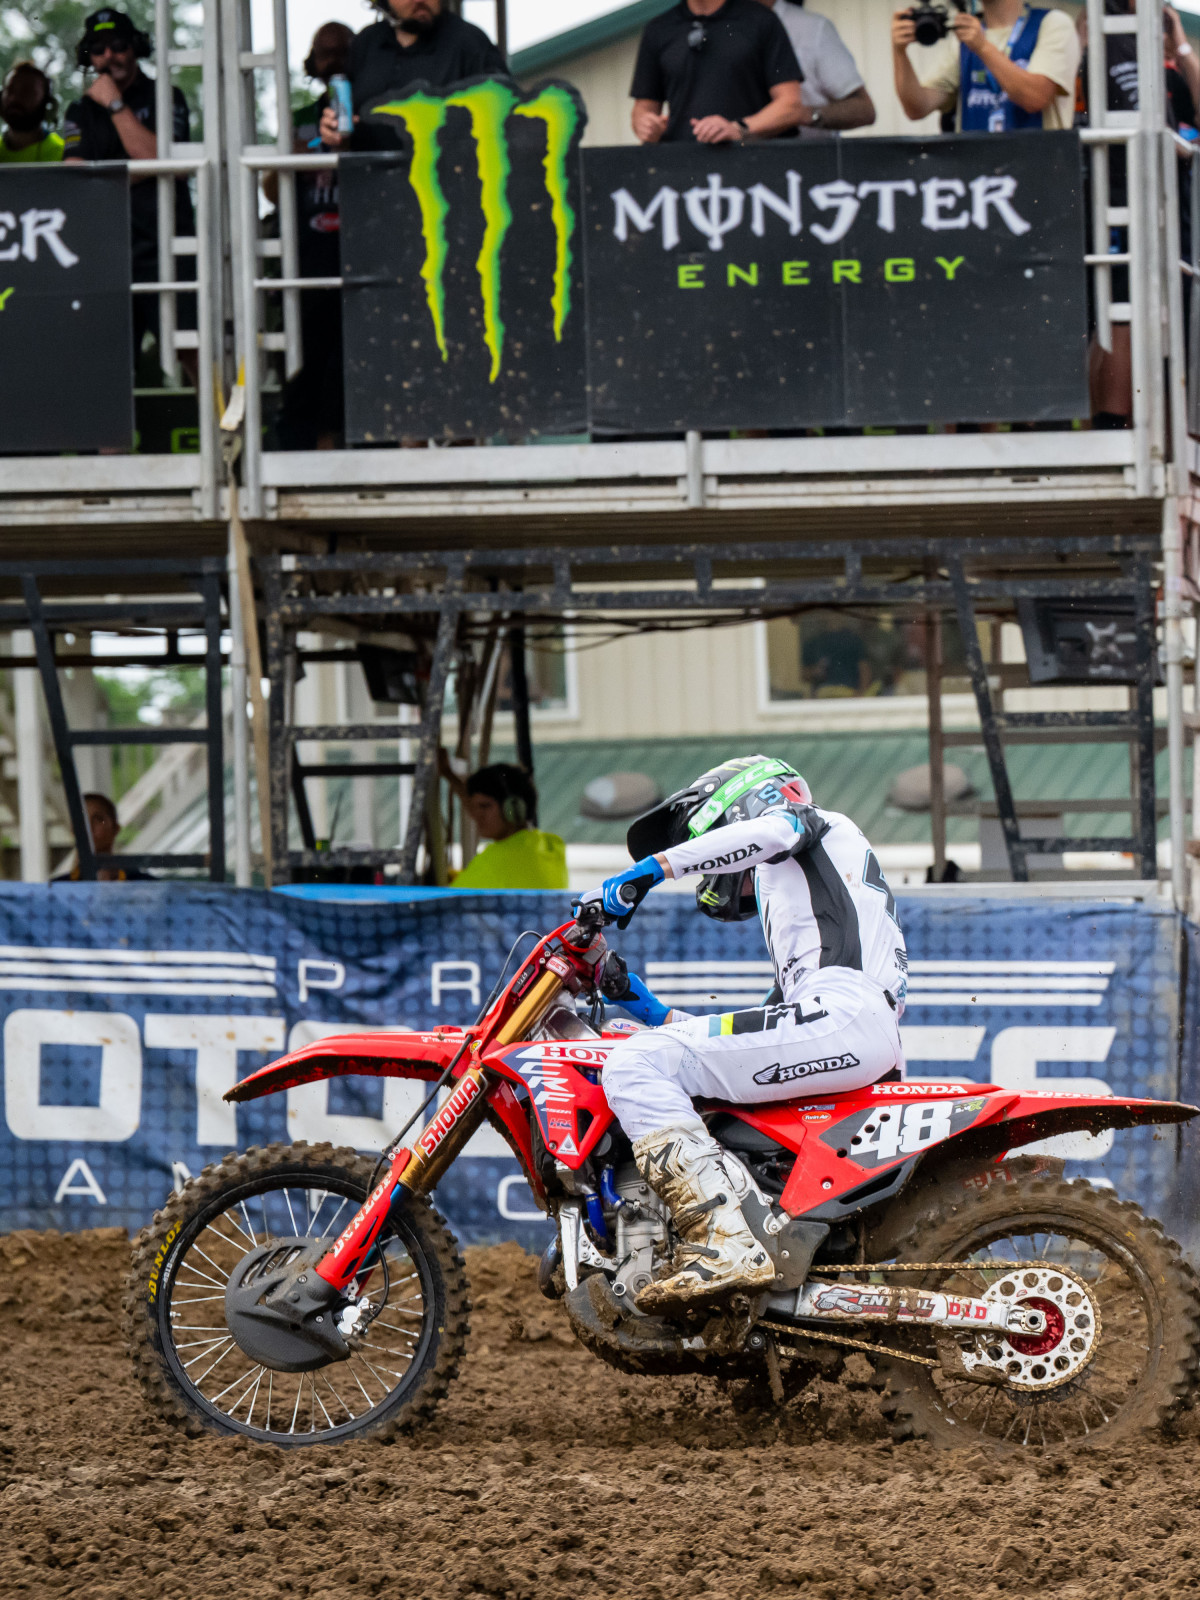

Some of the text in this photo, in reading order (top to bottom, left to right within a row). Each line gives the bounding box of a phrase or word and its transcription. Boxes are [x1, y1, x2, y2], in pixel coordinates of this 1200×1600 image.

[611, 171, 1031, 251] MONSTER
[677, 255, 965, 289] ENERGY
[682, 842, 763, 875] HONDA
[541, 1045, 609, 1063] HON
[779, 1053, 859, 1082] HONDA
[871, 1084, 968, 1096] HONDA
[420, 1075, 481, 1157] SHOWA
[850, 1101, 954, 1160] 48
